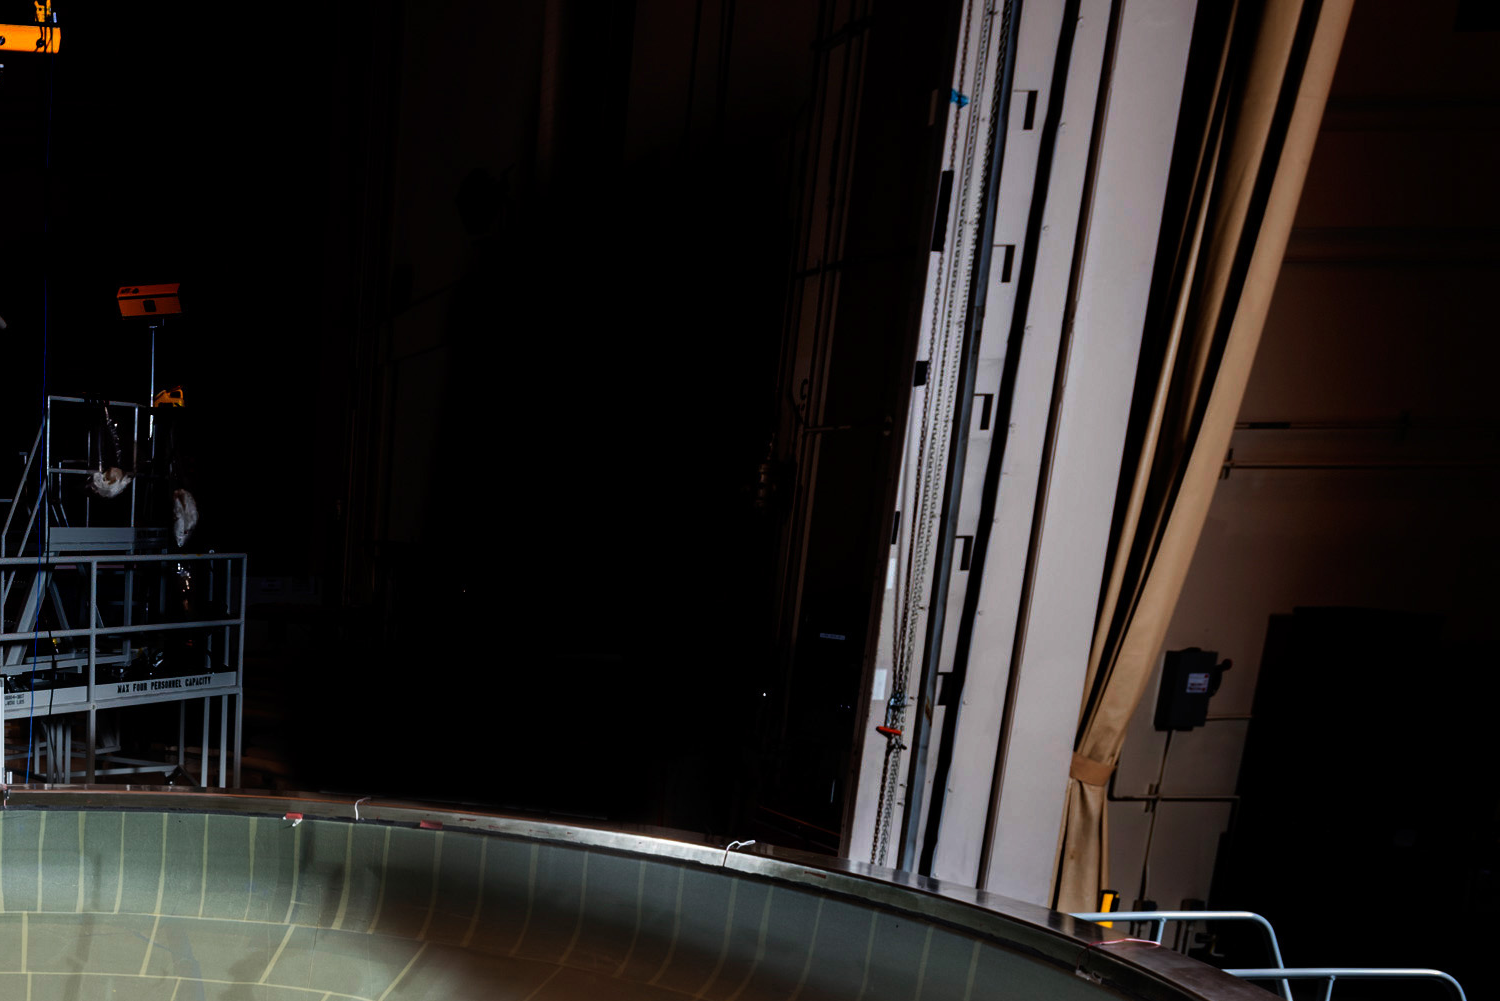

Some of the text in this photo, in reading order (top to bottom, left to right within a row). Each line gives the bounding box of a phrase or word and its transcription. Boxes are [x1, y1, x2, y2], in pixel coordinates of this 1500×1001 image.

[117, 676, 211, 693] MAX FOUR PERSONNEL CAPACITY
